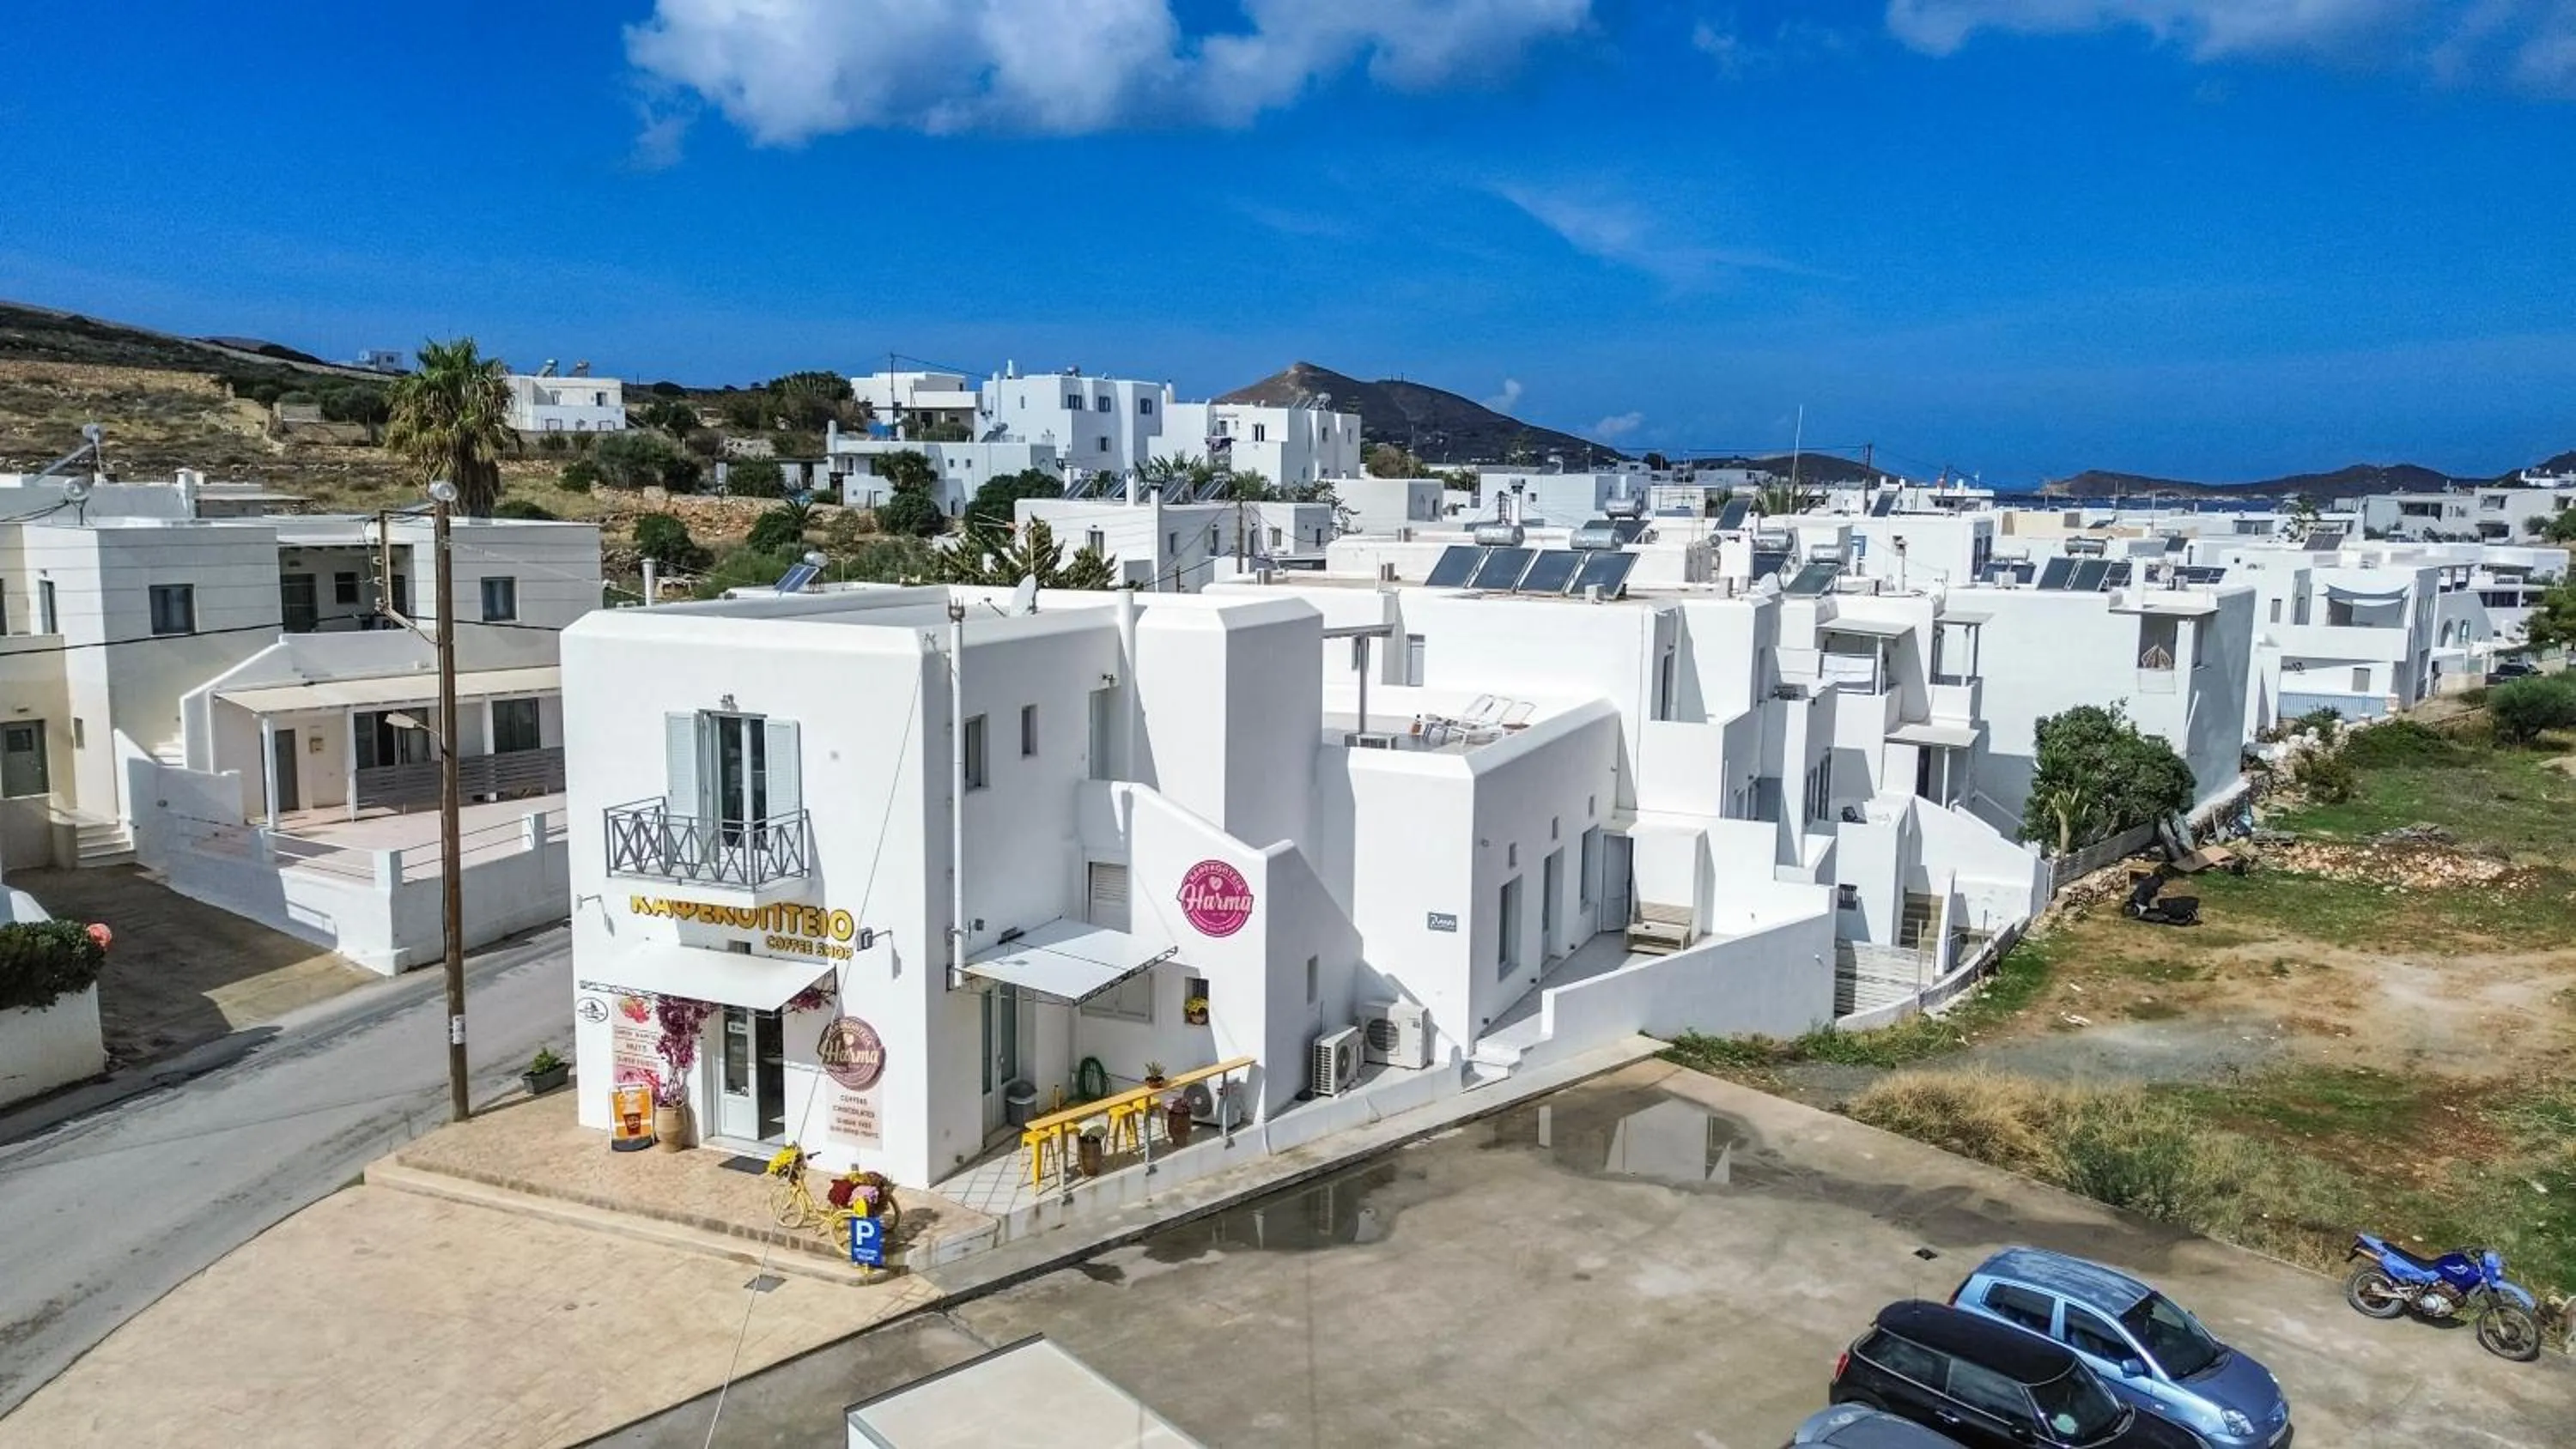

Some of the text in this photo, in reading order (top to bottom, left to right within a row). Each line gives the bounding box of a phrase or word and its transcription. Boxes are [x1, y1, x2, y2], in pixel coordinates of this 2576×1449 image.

[1179, 883, 1253, 912] Harma
[765, 934, 854, 961] COFFEE SHOP
[818, 1039, 879, 1064] Harma
[856, 1220, 875, 1246] P
